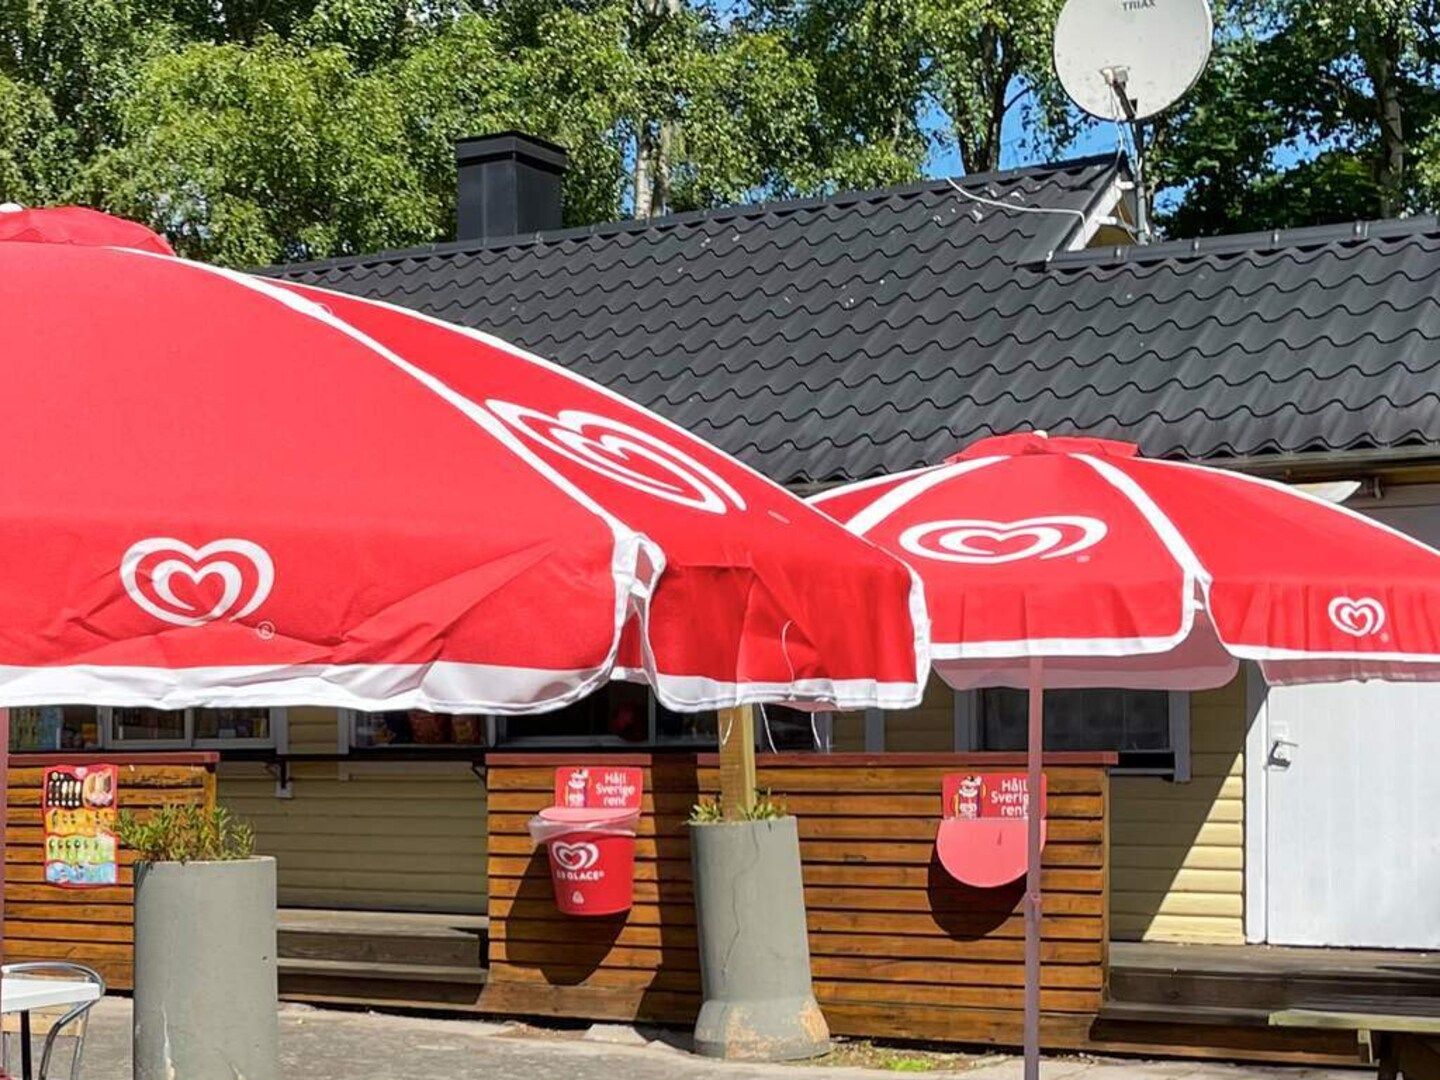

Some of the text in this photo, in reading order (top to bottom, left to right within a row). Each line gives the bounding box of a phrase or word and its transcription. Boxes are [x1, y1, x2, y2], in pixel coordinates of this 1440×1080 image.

[1122, 0, 1156, 11] TRIAX
[595, 782, 635, 798] Sverige
[1001, 777, 1028, 792] Håll
[990, 790, 1029, 807] Sverig
